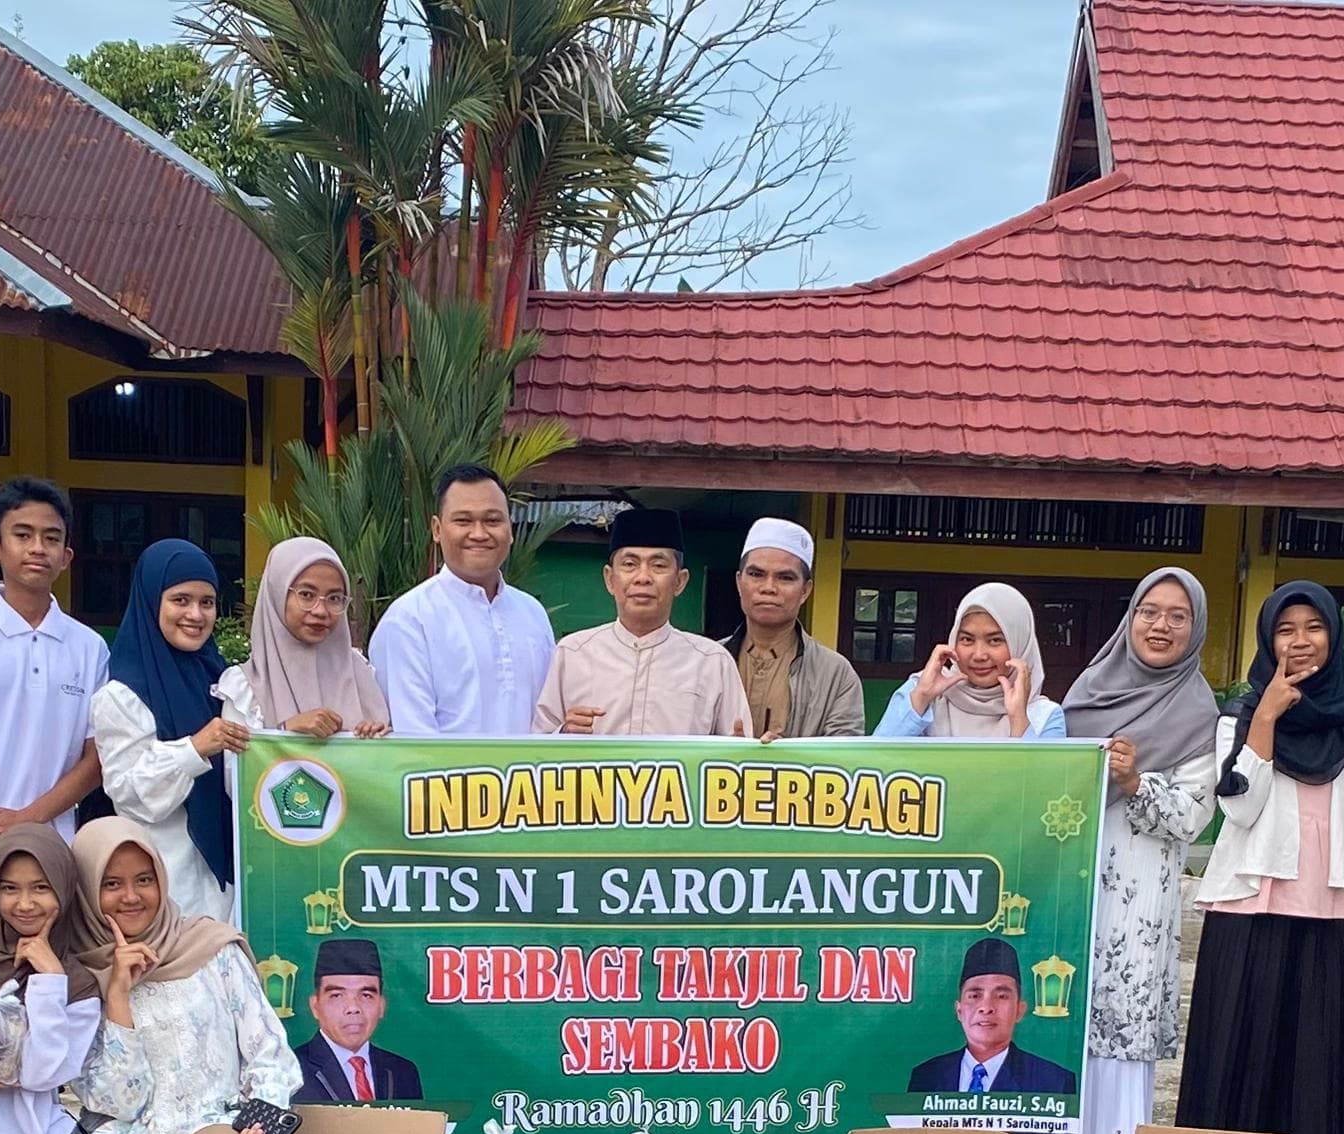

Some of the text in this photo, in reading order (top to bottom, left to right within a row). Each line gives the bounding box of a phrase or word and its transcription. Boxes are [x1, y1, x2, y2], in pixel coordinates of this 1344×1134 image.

[407, 765, 942, 837] INDAHNYA BERBAGI
[361, 865, 983, 915] MTS N 1 SAROLANGUN
[426, 946, 915, 1009] BERBAGI TAKJIL DAN
[562, 1017, 779, 1074] SEMBAKO
[494, 1081, 845, 1133] Ramadhan 1446 H
[923, 1095, 1065, 1116] Ahmad Fauzi, S.Ag
[962, 1118, 983, 1128] MTs
[986, 1118, 994, 1128] N
[998, 1118, 1003, 1128] 1
[1006, 1119, 1068, 1133] Sarolangun
